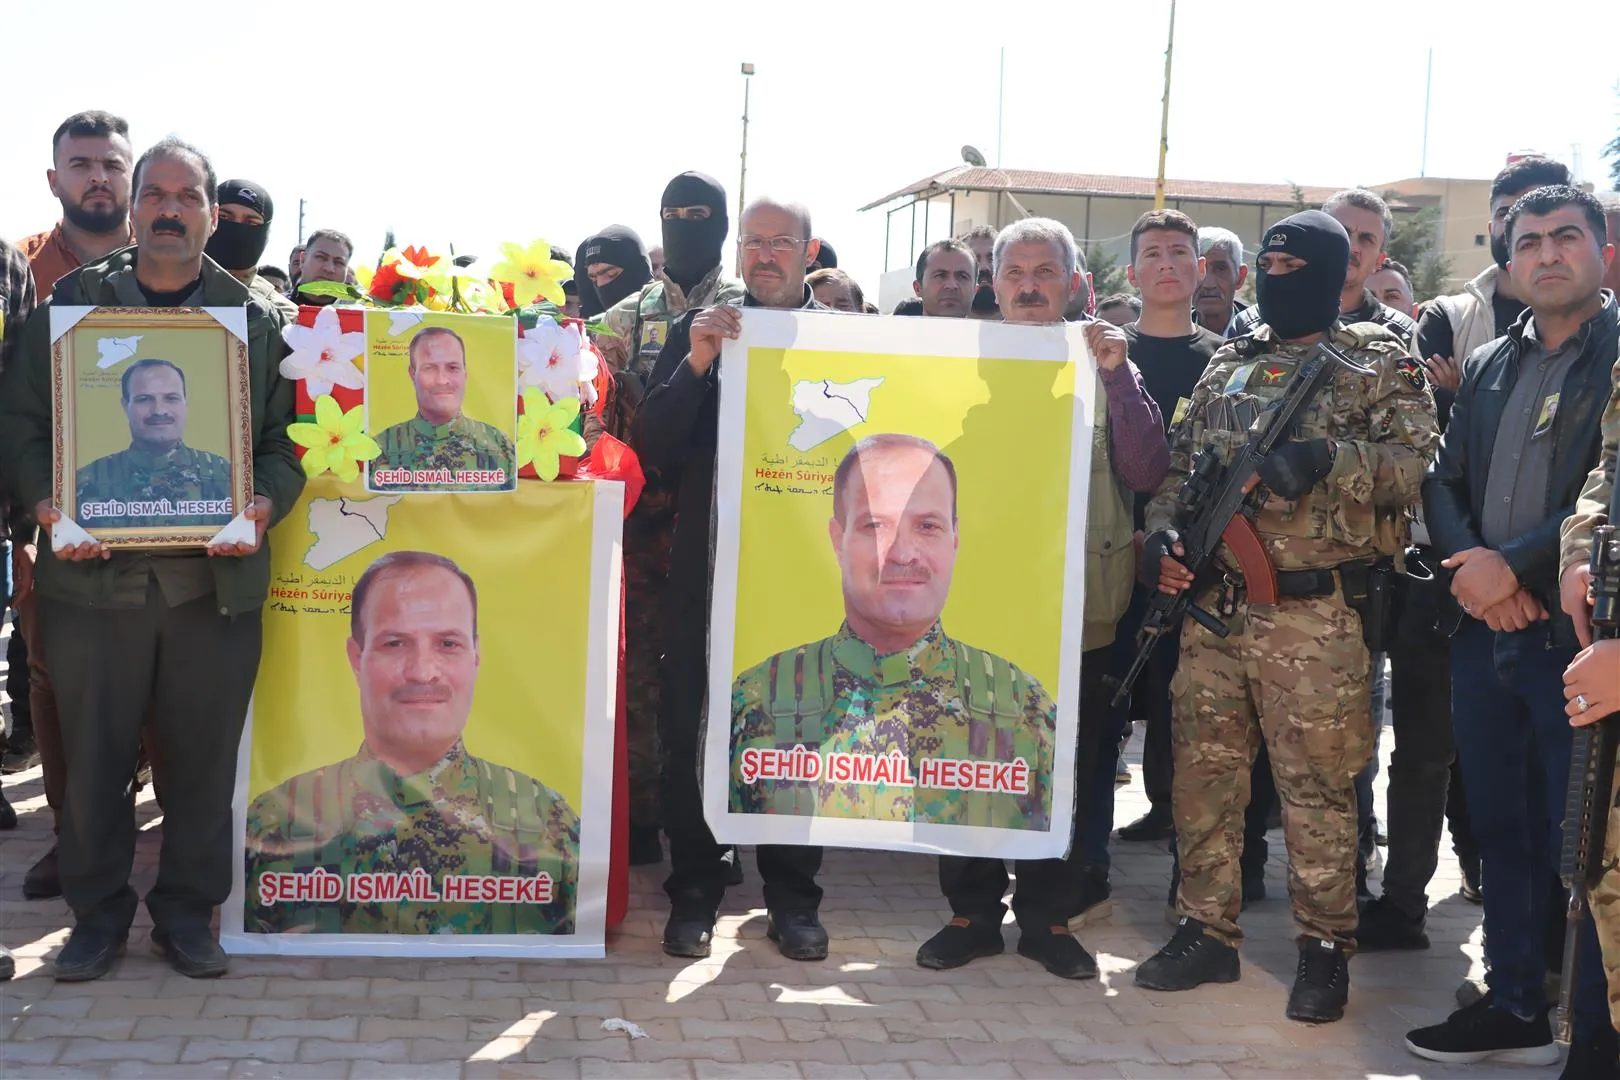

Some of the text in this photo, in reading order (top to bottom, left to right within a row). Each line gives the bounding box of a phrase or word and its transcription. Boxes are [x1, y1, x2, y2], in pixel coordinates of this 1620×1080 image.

[375, 468, 504, 486] ŞEHÎD ISMAÎL HESEKÊ
[755, 467, 834, 485] Hêzên Sûriya
[82, 498, 233, 519] ŞEHÎD ISMAÎL HESEKÊ
[271, 586, 352, 603] Hêzên Sûriya
[742, 746, 1027, 791] ŞEHÎD ISMAÎL HESEKÊ
[261, 869, 551, 904] ŞEHÎD ISMAÎL HESEKÊ
